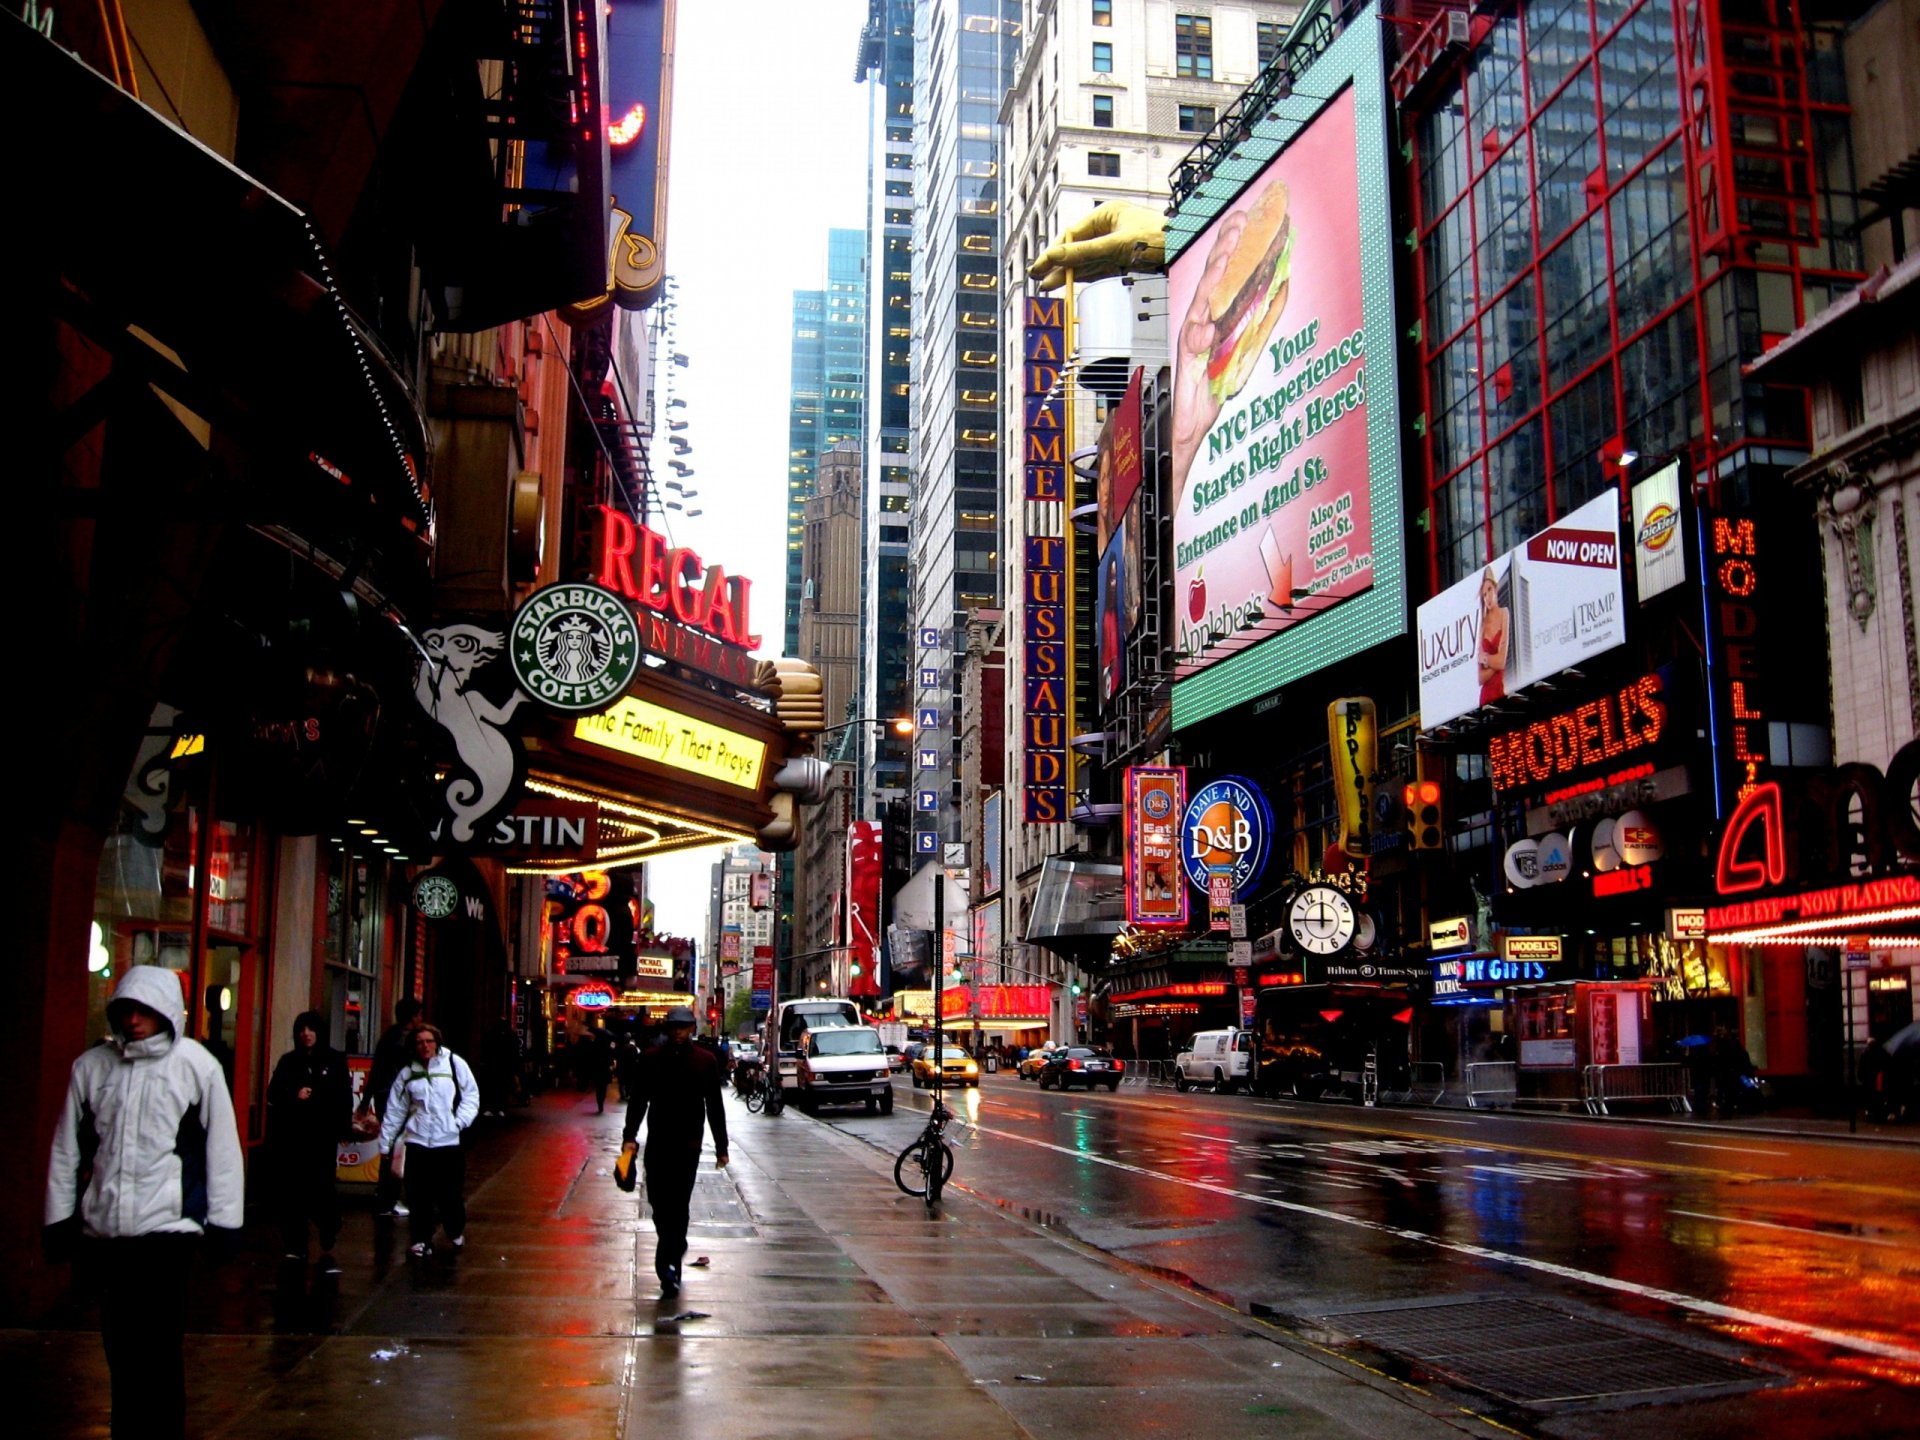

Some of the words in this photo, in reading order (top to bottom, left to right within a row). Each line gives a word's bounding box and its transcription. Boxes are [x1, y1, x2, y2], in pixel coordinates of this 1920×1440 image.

[1269, 317, 1320, 375] Your
[1027, 298, 1062, 497] MADAME
[1208, 408, 1247, 462] NYC
[1250, 330, 1365, 433] Experience
[1192, 457, 1245, 514] Starts
[1249, 420, 1303, 475] Right
[1306, 369, 1367, 439] Here!
[1176, 513, 1238, 570] Entrance
[1240, 503, 1259, 526] on
[1261, 473, 1302, 517] 42nd
[1304, 455, 1328, 489] St.
[1309, 504, 1334, 530] Also
[1336, 495, 1351, 513] on
[1641, 514, 1677, 541] Dickies
[1309, 525, 1335, 555] 50th
[1336, 517, 1353, 537] St.
[1547, 538, 1580, 561] NOW
[1581, 541, 1615, 565] OPEN
[1315, 546, 1348, 570] between
[1339, 565, 1354, 580] 7th
[1354, 555, 1372, 572] Ave.
[598, 504, 763, 651] REGAL
[517, 589, 632, 646] STARBUCKS
[1578, 592, 1615, 626] TRUMP
[1178, 594, 1263, 664] Applebee's
[1420, 608, 1479, 673] luxury
[528, 668, 619, 703] COFFEE
[1031, 537, 1061, 821] TUSSAUD'S
[620, 710, 672, 759] Family
[679, 730, 713, 760] That
[717, 741, 753, 785] Preys
[1488, 674, 1663, 791] MODELL'S
[1146, 798, 1169, 809] D&B
[1190, 786, 1220, 820] DAVE
[1222, 785, 1252, 813] AND
[1143, 823, 1172, 834] Eat
[1190, 819, 1253, 859] D&B
[1143, 846, 1172, 859] Play
[1542, 863, 1567, 873] adidas
[1212, 877, 1229, 889] NEW
[1303, 892, 1316, 906] 12
[1799, 888, 1839, 918] NOW
[1840, 874, 1917, 912] PLAYING
[1340, 902, 1349, 913] 3
[1708, 902, 1752, 930] EAGLE
[1753, 897, 1782, 924] EYE
[1294, 929, 1303, 940] 9
[1331, 938, 1339, 949] 6
[1509, 941, 1558, 952] MODELL'S
[1326, 966, 1358, 976] Hilton
[1377, 968, 1405, 977] Times
[1465, 959, 1486, 981] NY
[1488, 959, 1546, 981] GIFTS
